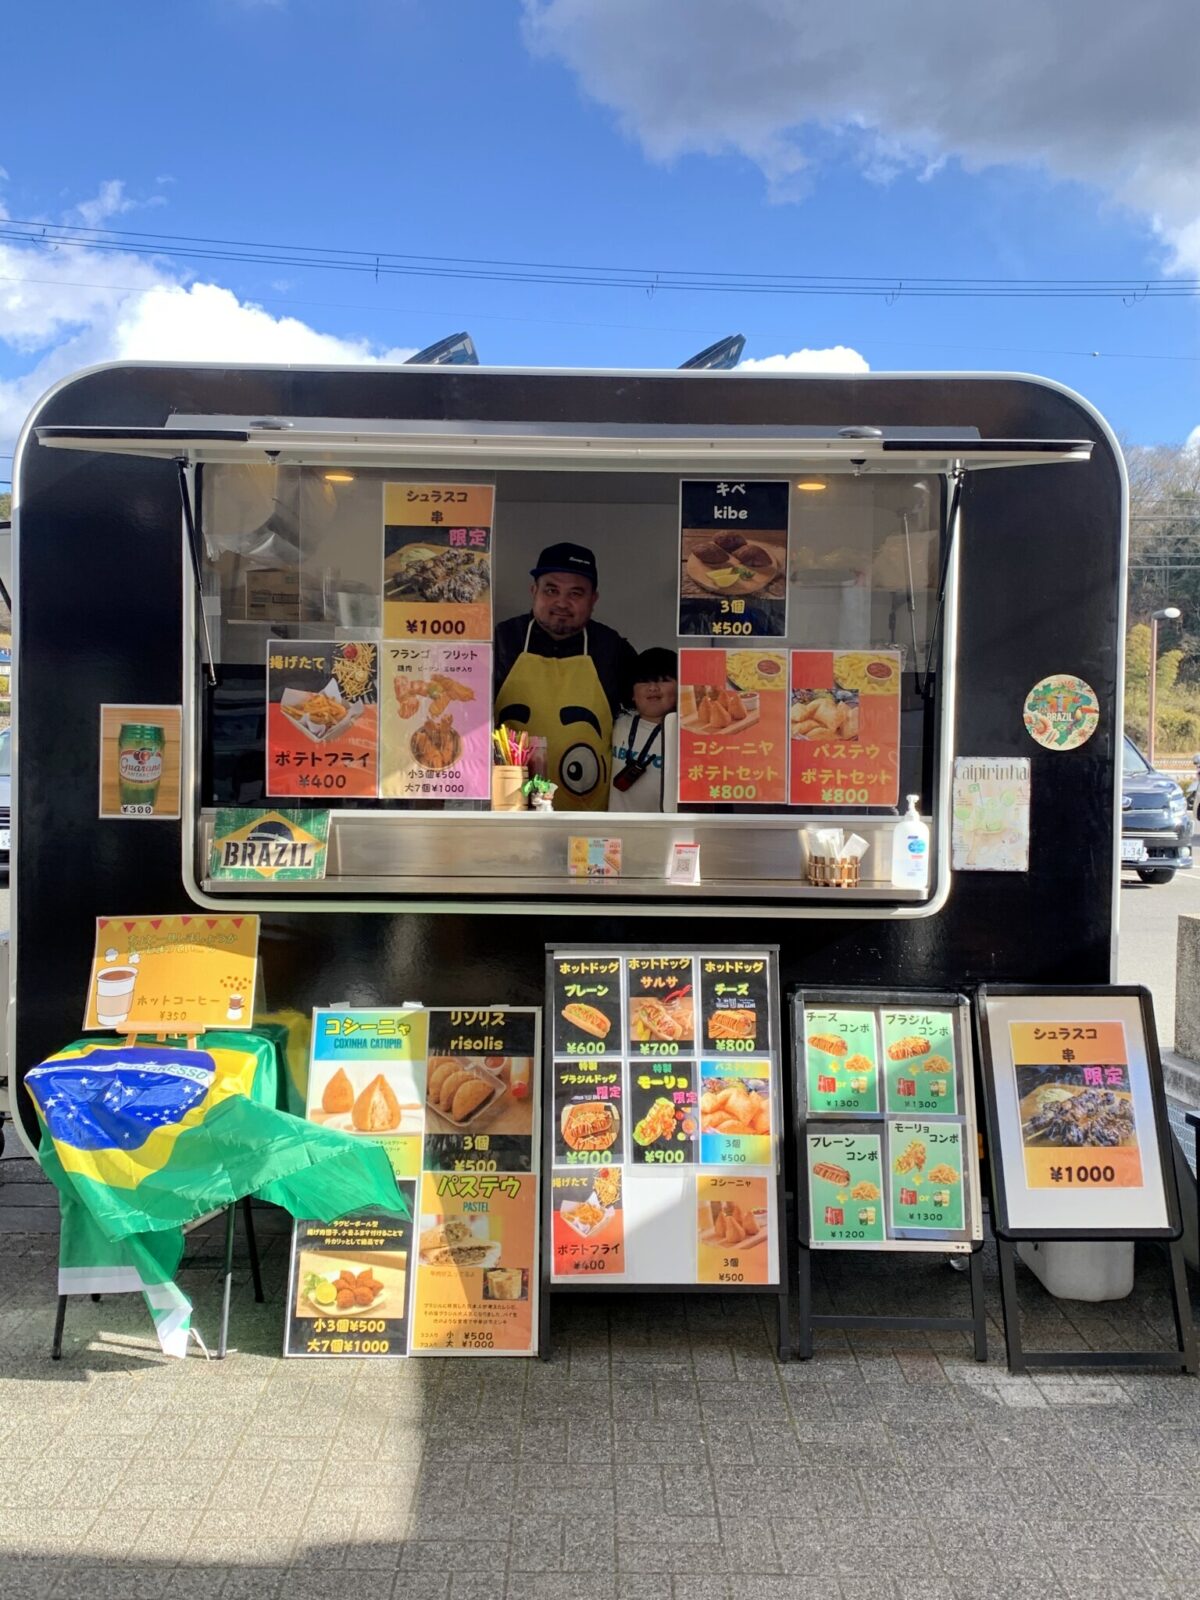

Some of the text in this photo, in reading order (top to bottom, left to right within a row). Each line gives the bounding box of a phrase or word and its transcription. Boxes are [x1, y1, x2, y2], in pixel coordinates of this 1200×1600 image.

[716, 482, 746, 496] キベ
[406, 490, 468, 502] シュラスコ
[431, 510, 444, 524] 串
[713, 505, 749, 519] kibe
[449, 528, 487, 546] 限定
[720, 600, 746, 614] 3個
[405, 620, 465, 634] ¥1000
[711, 621, 752, 635] ¥500
[443, 649, 478, 660] フリット
[269, 655, 325, 670] 揚げたて
[1047, 712, 1074, 722] BRAZIL
[812, 744, 880, 760] パステウ
[275, 751, 370, 769] ポテトフライ
[407, 769, 461, 780] 小3個¥500
[687, 764, 778, 781] ポテトセット
[801, 768, 893, 785] ポテトセット
[298, 774, 347, 789] ¥400
[404, 783, 465, 793] 大7個¥1000
[709, 784, 757, 800] ¥800
[821, 788, 869, 803] ¥800
[122, 805, 152, 814] ¥300
[223, 842, 314, 867] BRAZIL
[559, 962, 620, 975] ホットドッグ
[629, 957, 690, 970] ホットドッグ
[704, 961, 764, 974] ホットドッグ
[640, 976, 679, 989] サルサ
[714, 983, 750, 996] チーズ
[136, 995, 221, 1007] ホットコーヒー
[159, 1010, 187, 1021] ¥350
[450, 1010, 506, 1026] リソリス
[806, 1012, 838, 1022] チーズ
[885, 1014, 933, 1026] ブラジル
[325, 1017, 412, 1037] コシーニャ
[839, 1023, 871, 1034] コンボ
[918, 1026, 950, 1037] コンボ
[1033, 1027, 1098, 1041] シュラスコ
[333, 1038, 369, 1050] COXINHA
[450, 1036, 504, 1051] risolis
[566, 1042, 606, 1055] ¥600
[639, 1043, 679, 1056] ¥700
[715, 1039, 755, 1053] ¥800
[1062, 1048, 1076, 1062] 串
[560, 1073, 617, 1084] ブラジルドッグ
[637, 1076, 688, 1090] モーリョ
[1083, 1067, 1123, 1086] 限定
[596, 1085, 621, 1099] 限定
[672, 1091, 698, 1105] 限定
[826, 1098, 860, 1108] ¥1300
[905, 1100, 938, 1110] ¥1300
[894, 1123, 930, 1133] モーリョ
[462, 1136, 490, 1151] 3個
[724, 1138, 741, 1149] 3個
[929, 1133, 959, 1144] コンボ
[566, 1151, 612, 1165] ¥900
[644, 1150, 685, 1163] ¥900
[721, 1153, 746, 1163] ¥500
[846, 1151, 879, 1162] コンボ
[454, 1159, 498, 1172] ¥500
[1050, 1165, 1115, 1182] ¥1000
[437, 1175, 522, 1199] パステウ
[463, 1201, 491, 1213] PASTEL
[909, 1213, 943, 1222] ¥1300
[831, 1230, 865, 1239] ¥1200
[557, 1243, 621, 1256] ポテトフライ
[573, 1259, 605, 1271] ¥400
[723, 1257, 740, 1268] 3個
[718, 1272, 744, 1283] ¥500
[313, 1318, 386, 1334] 小3個¥500
[447, 1330, 454, 1340] 小
[464, 1331, 493, 1341] ¥500
[307, 1338, 390, 1353] 大7個¥1000
[446, 1340, 454, 1348] 大
[462, 1340, 494, 1349] ¥1000
